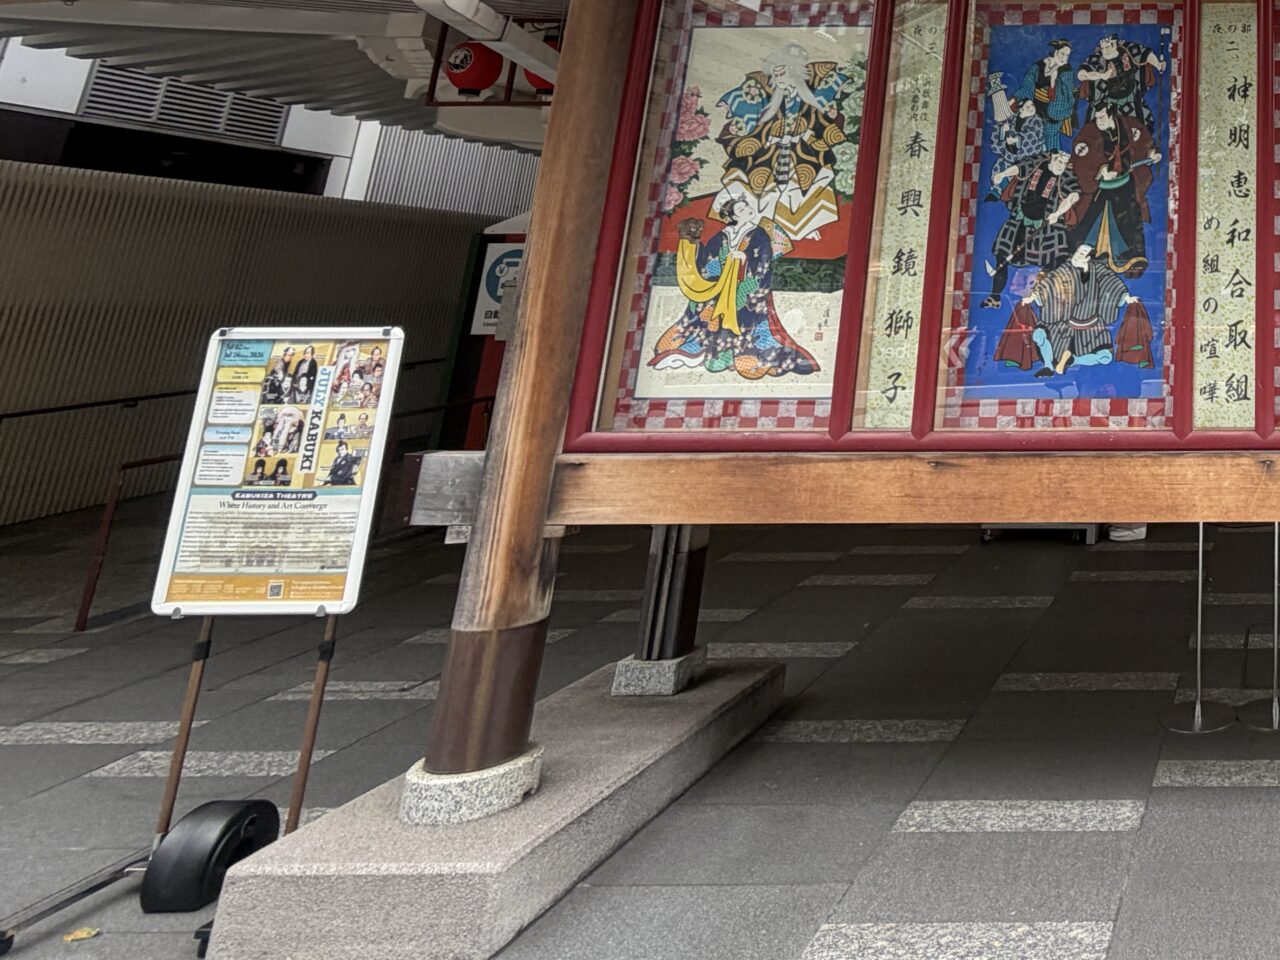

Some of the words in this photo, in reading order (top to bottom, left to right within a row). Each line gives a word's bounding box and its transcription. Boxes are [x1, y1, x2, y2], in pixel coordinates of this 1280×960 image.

[1212, 23, 1252, 35] 夜の部
[880, 131, 929, 404] 春興鏡獅子
[1200, 216, 1221, 404] め組の喧嘩
[313, 367, 332, 407] JULY
[301, 409, 322, 471] KABUKI
[241, 502, 266, 510] History
